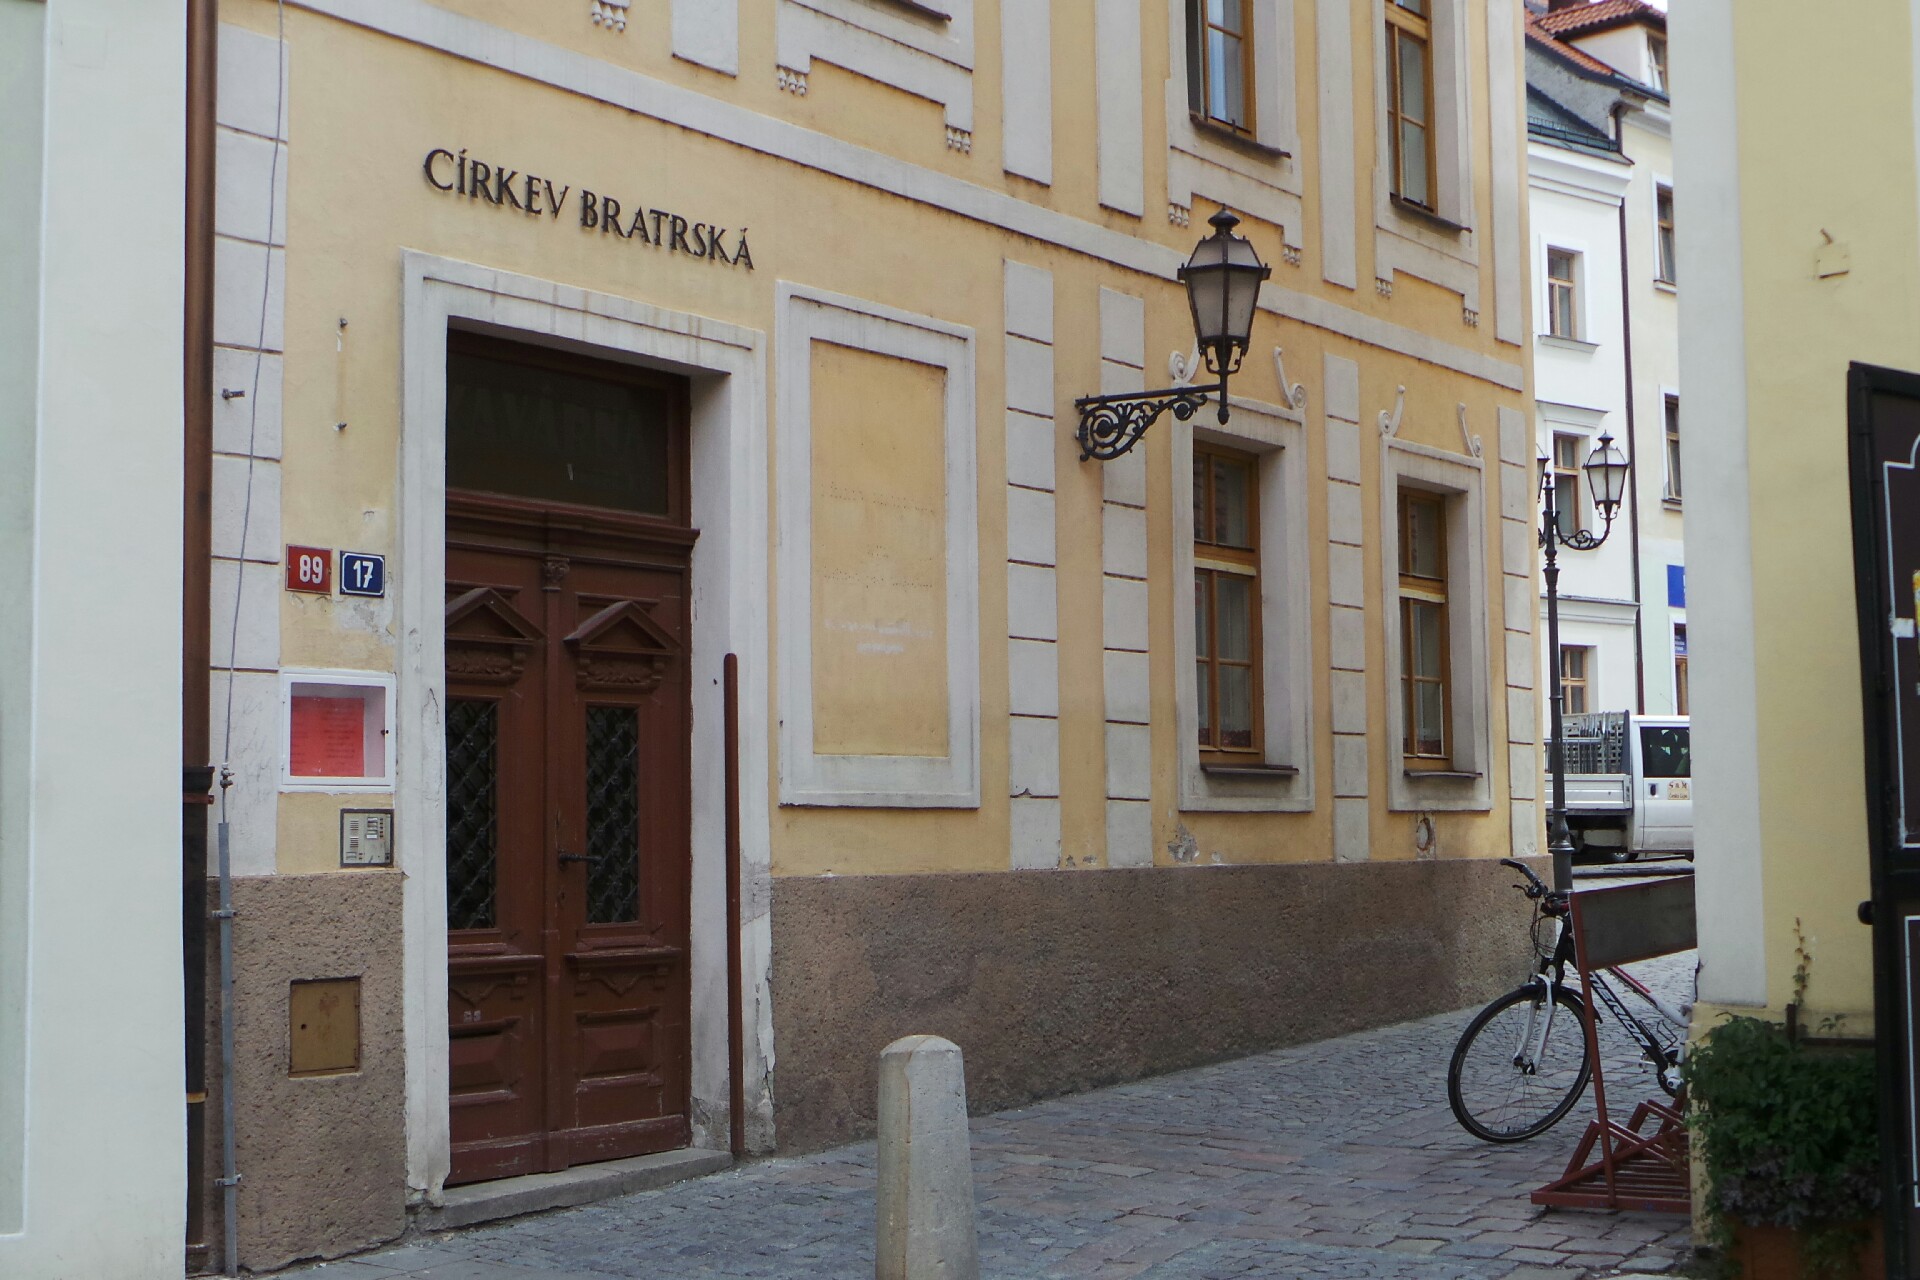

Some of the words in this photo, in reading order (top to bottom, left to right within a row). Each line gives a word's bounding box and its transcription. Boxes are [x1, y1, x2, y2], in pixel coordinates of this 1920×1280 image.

[423, 149, 569, 219] CÍRKEV
[580, 189, 755, 271] BRATRSKÁ
[300, 555, 323, 584] 89
[353, 560, 374, 588] 17
